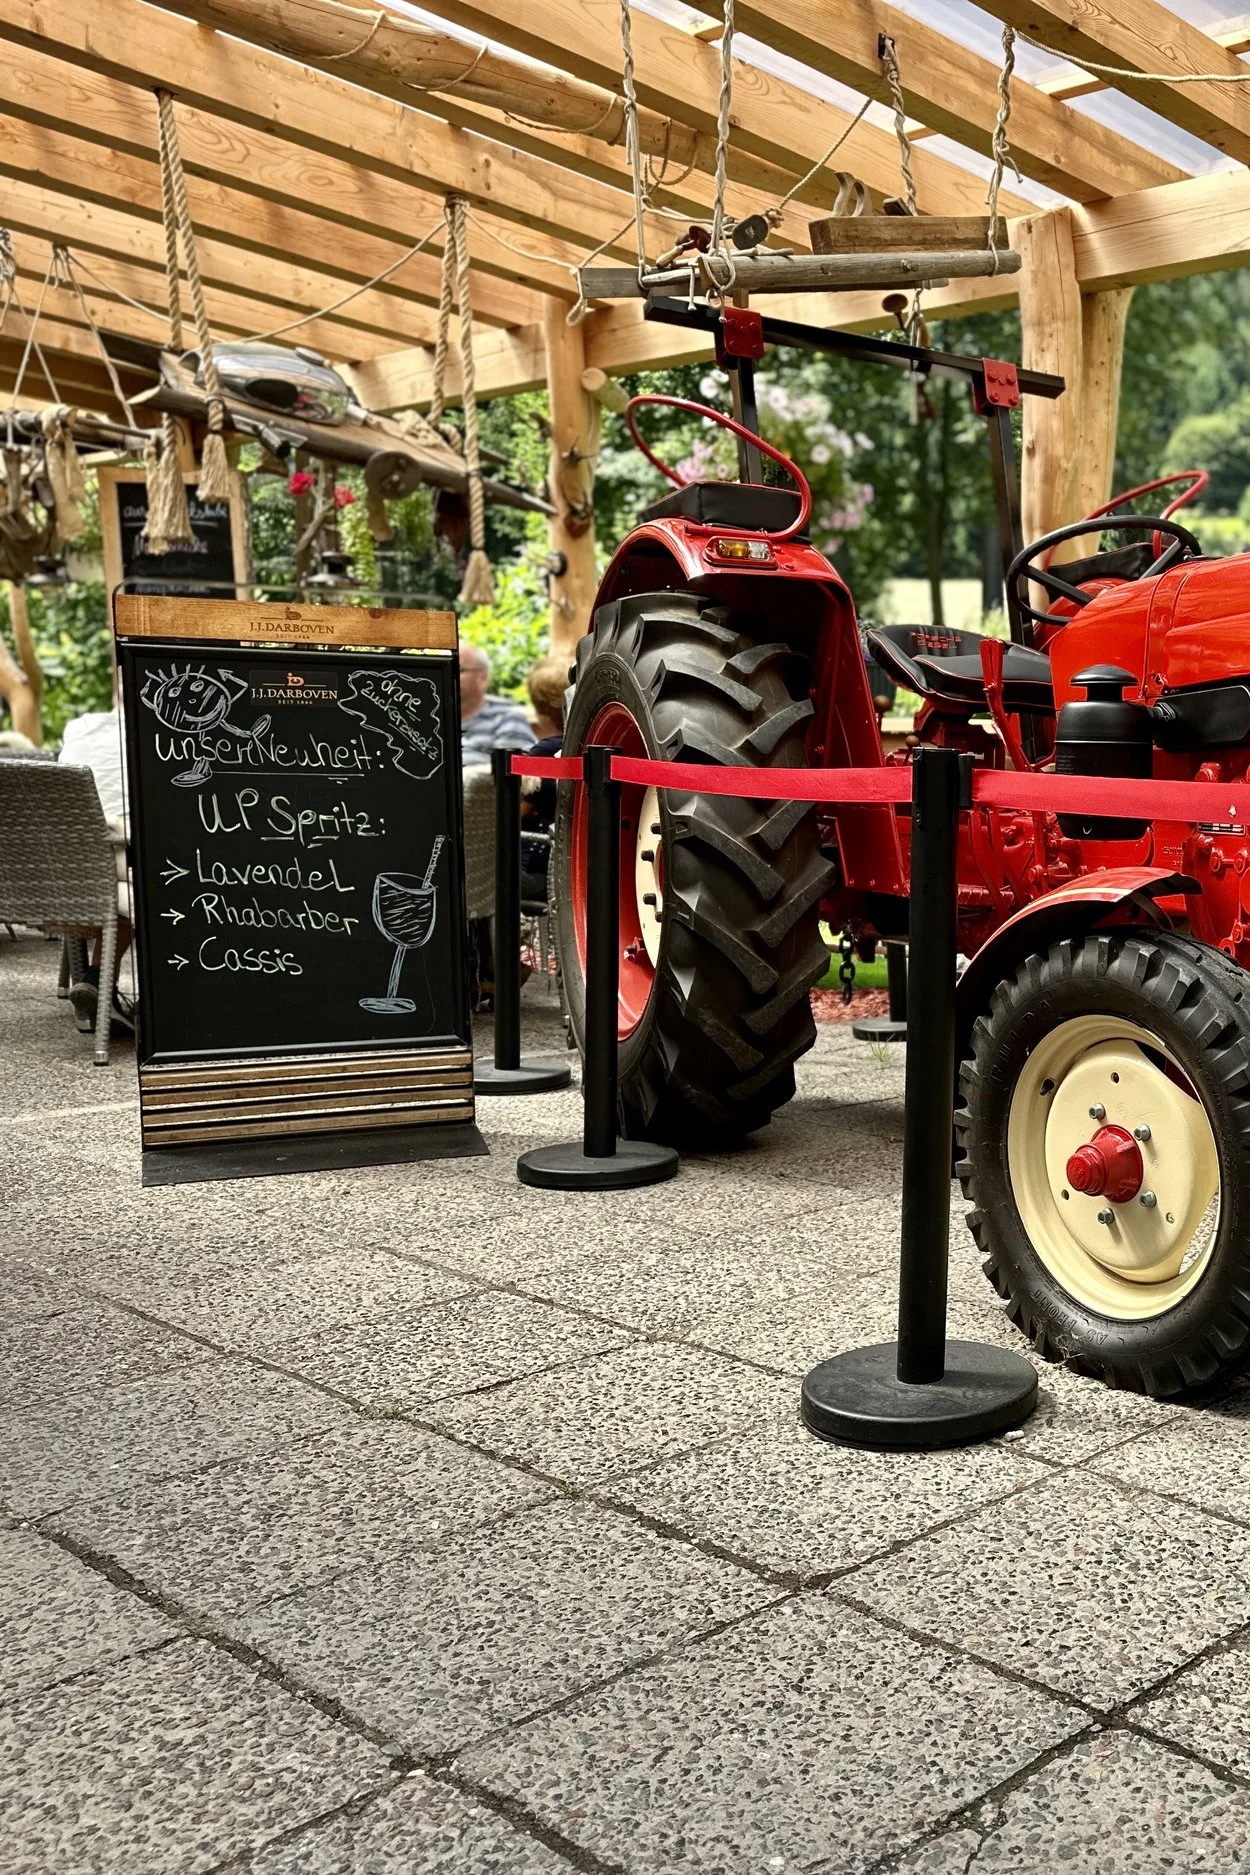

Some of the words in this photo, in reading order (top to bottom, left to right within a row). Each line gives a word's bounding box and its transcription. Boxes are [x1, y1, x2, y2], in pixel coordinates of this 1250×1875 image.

[381, 679, 422, 713] ohne
[252, 732, 385, 770] Neuheit:
[266, 795, 387, 846] Spritz:
[192, 893, 359, 935] Rhabarber
[199, 936, 303, 975] Cassis
